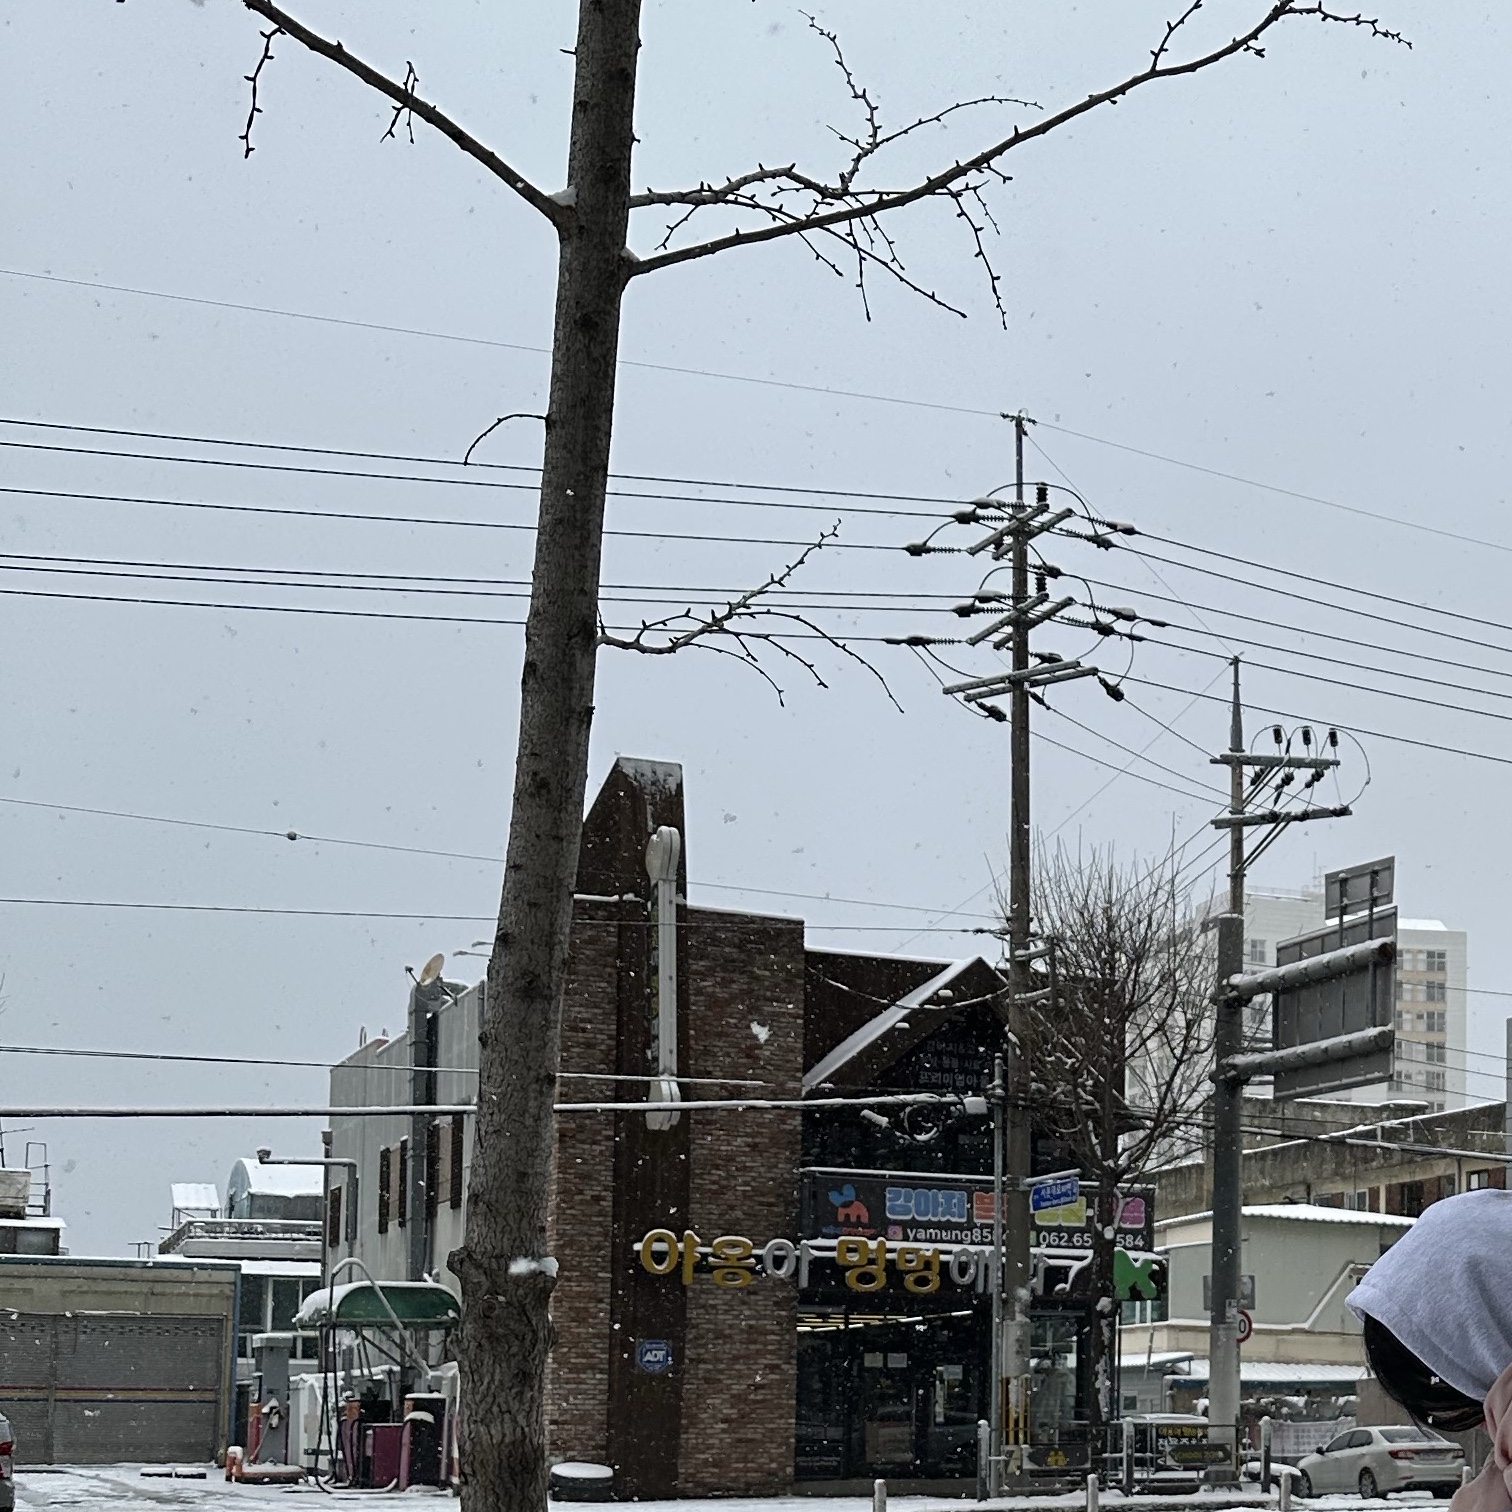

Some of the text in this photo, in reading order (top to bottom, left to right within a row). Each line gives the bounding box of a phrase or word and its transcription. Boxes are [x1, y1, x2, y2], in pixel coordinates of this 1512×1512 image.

[907, 1228, 1007, 1244] yamung85
[639, 1229, 815, 1288] 야옹아
[643, 1350, 665, 1362] ADT
